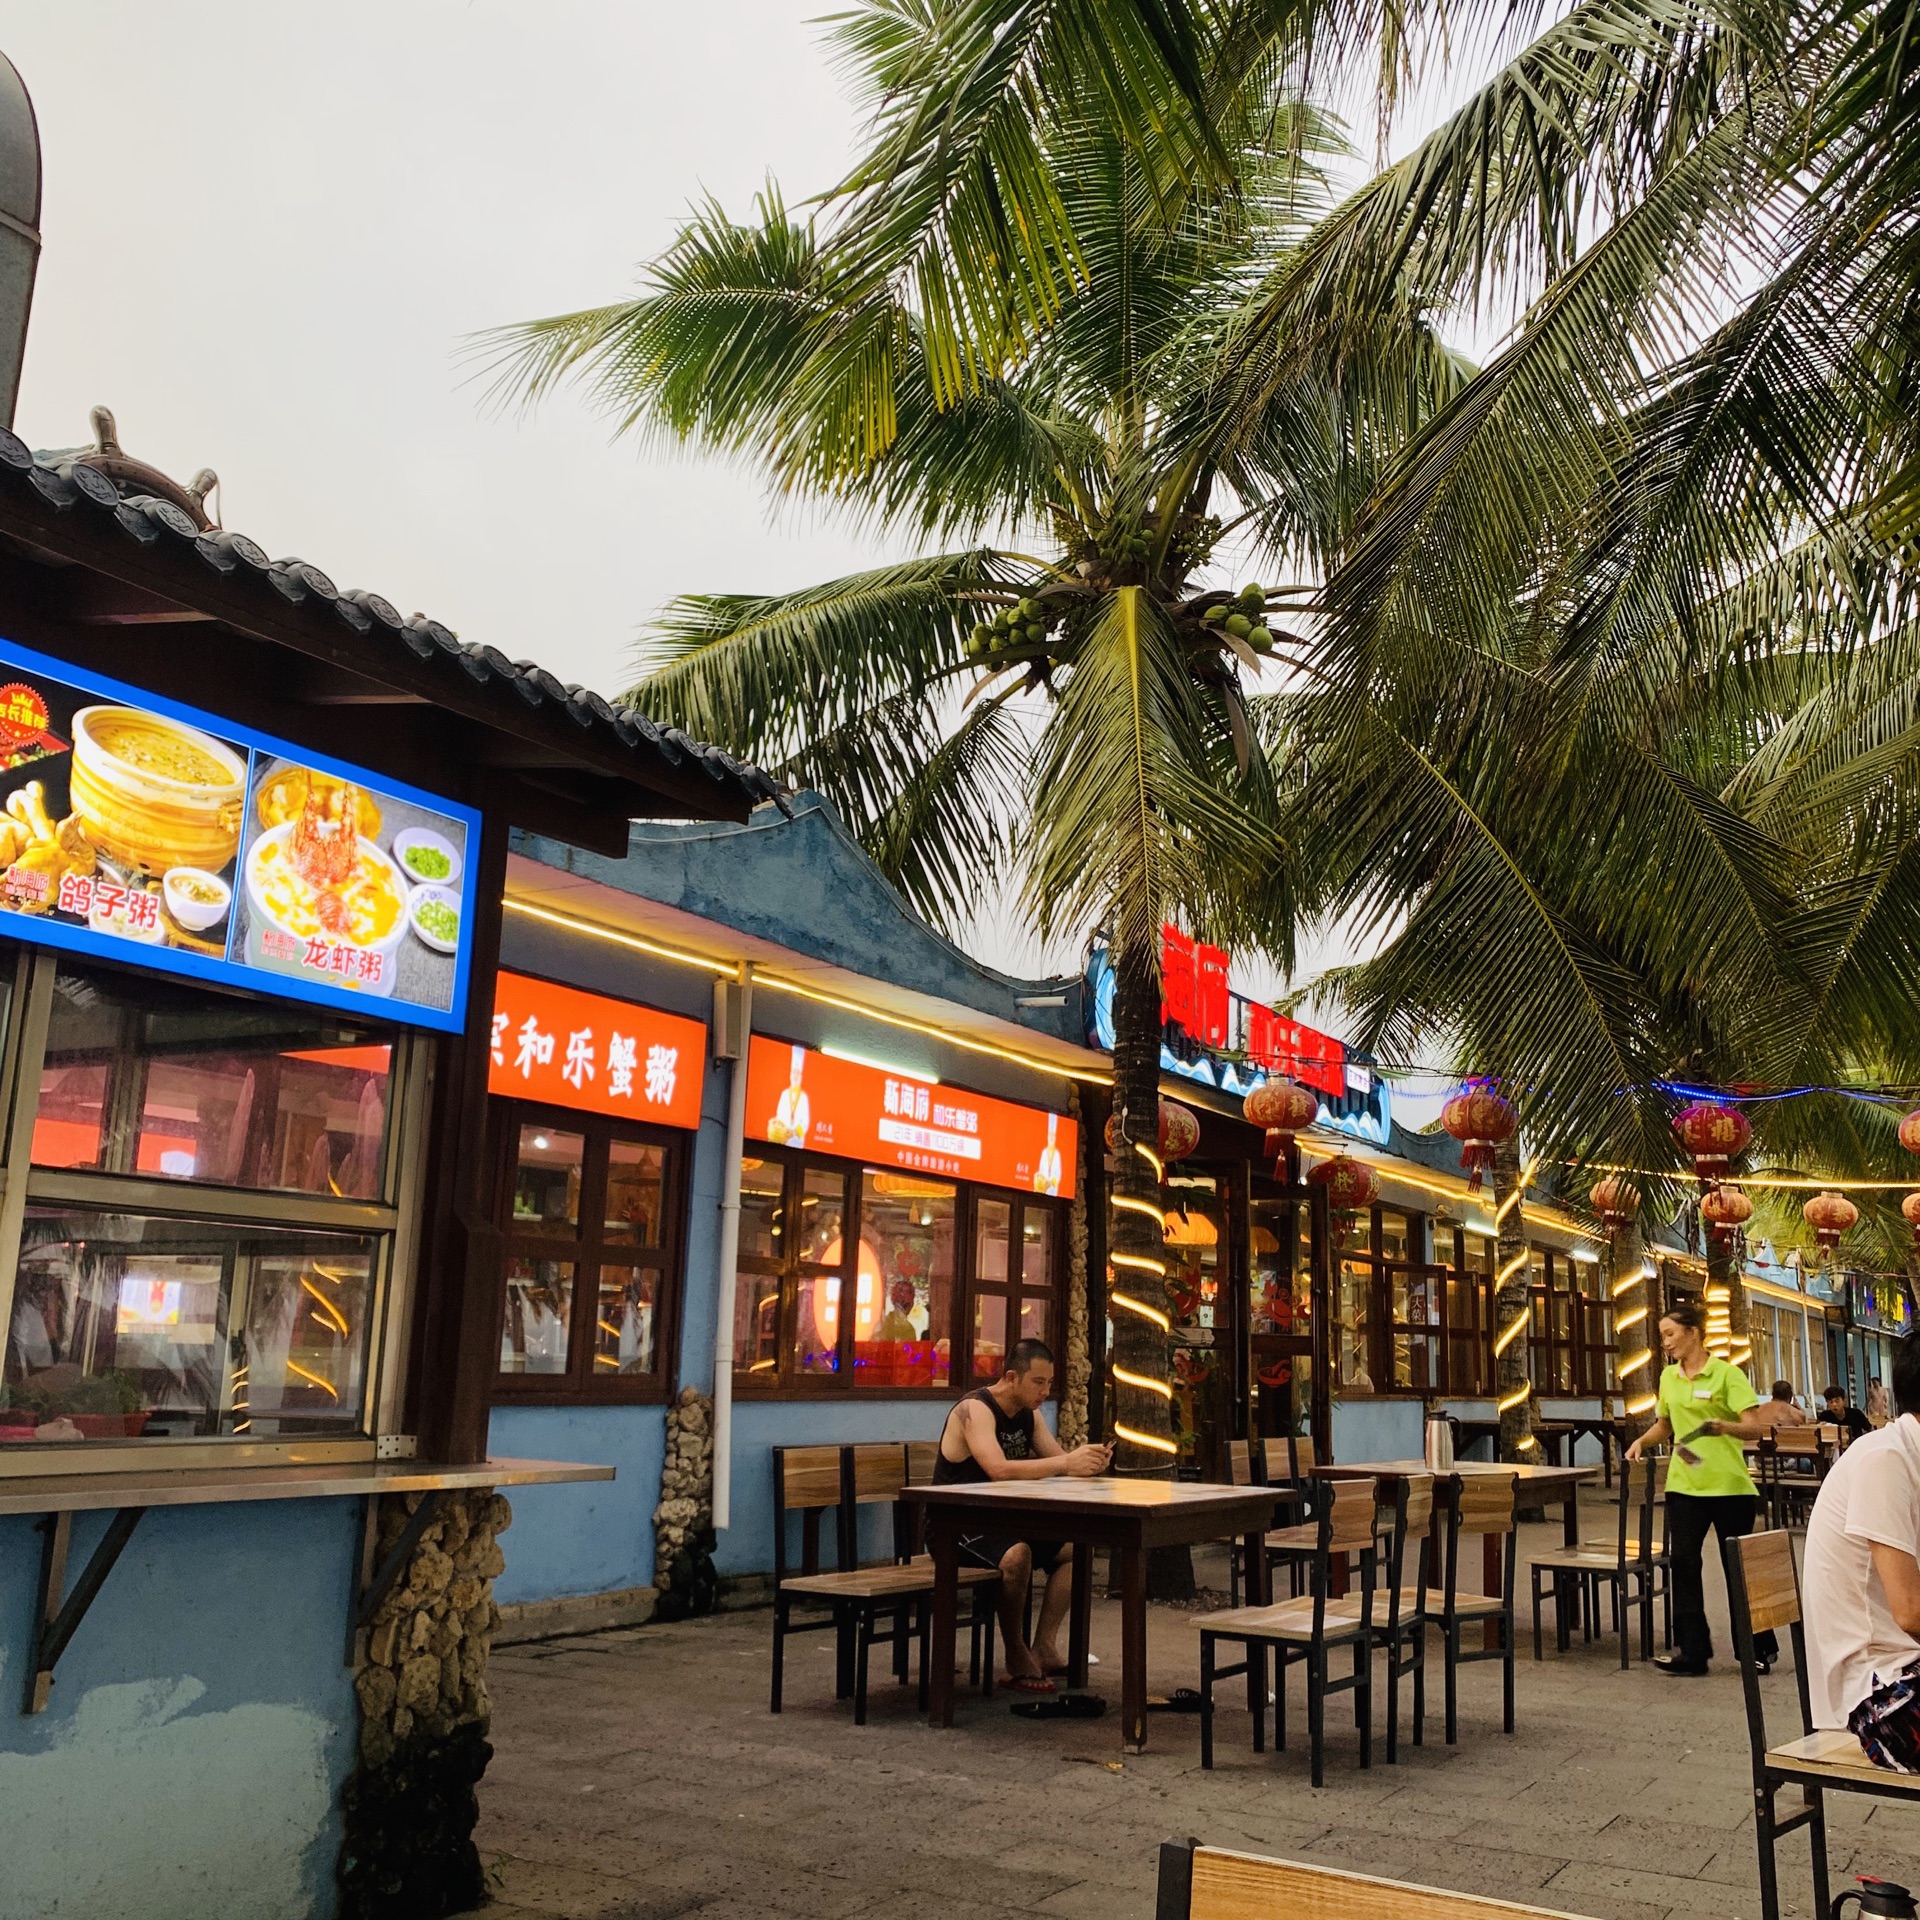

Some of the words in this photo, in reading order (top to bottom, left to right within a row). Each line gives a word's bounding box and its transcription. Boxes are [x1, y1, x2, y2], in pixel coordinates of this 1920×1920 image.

[60, 875, 159, 929] 鸽子粥
[303, 937, 383, 982] 龙虾粥
[884, 1079, 930, 1121] 新海府
[933, 1104, 978, 1133] 和乐蟹粥
